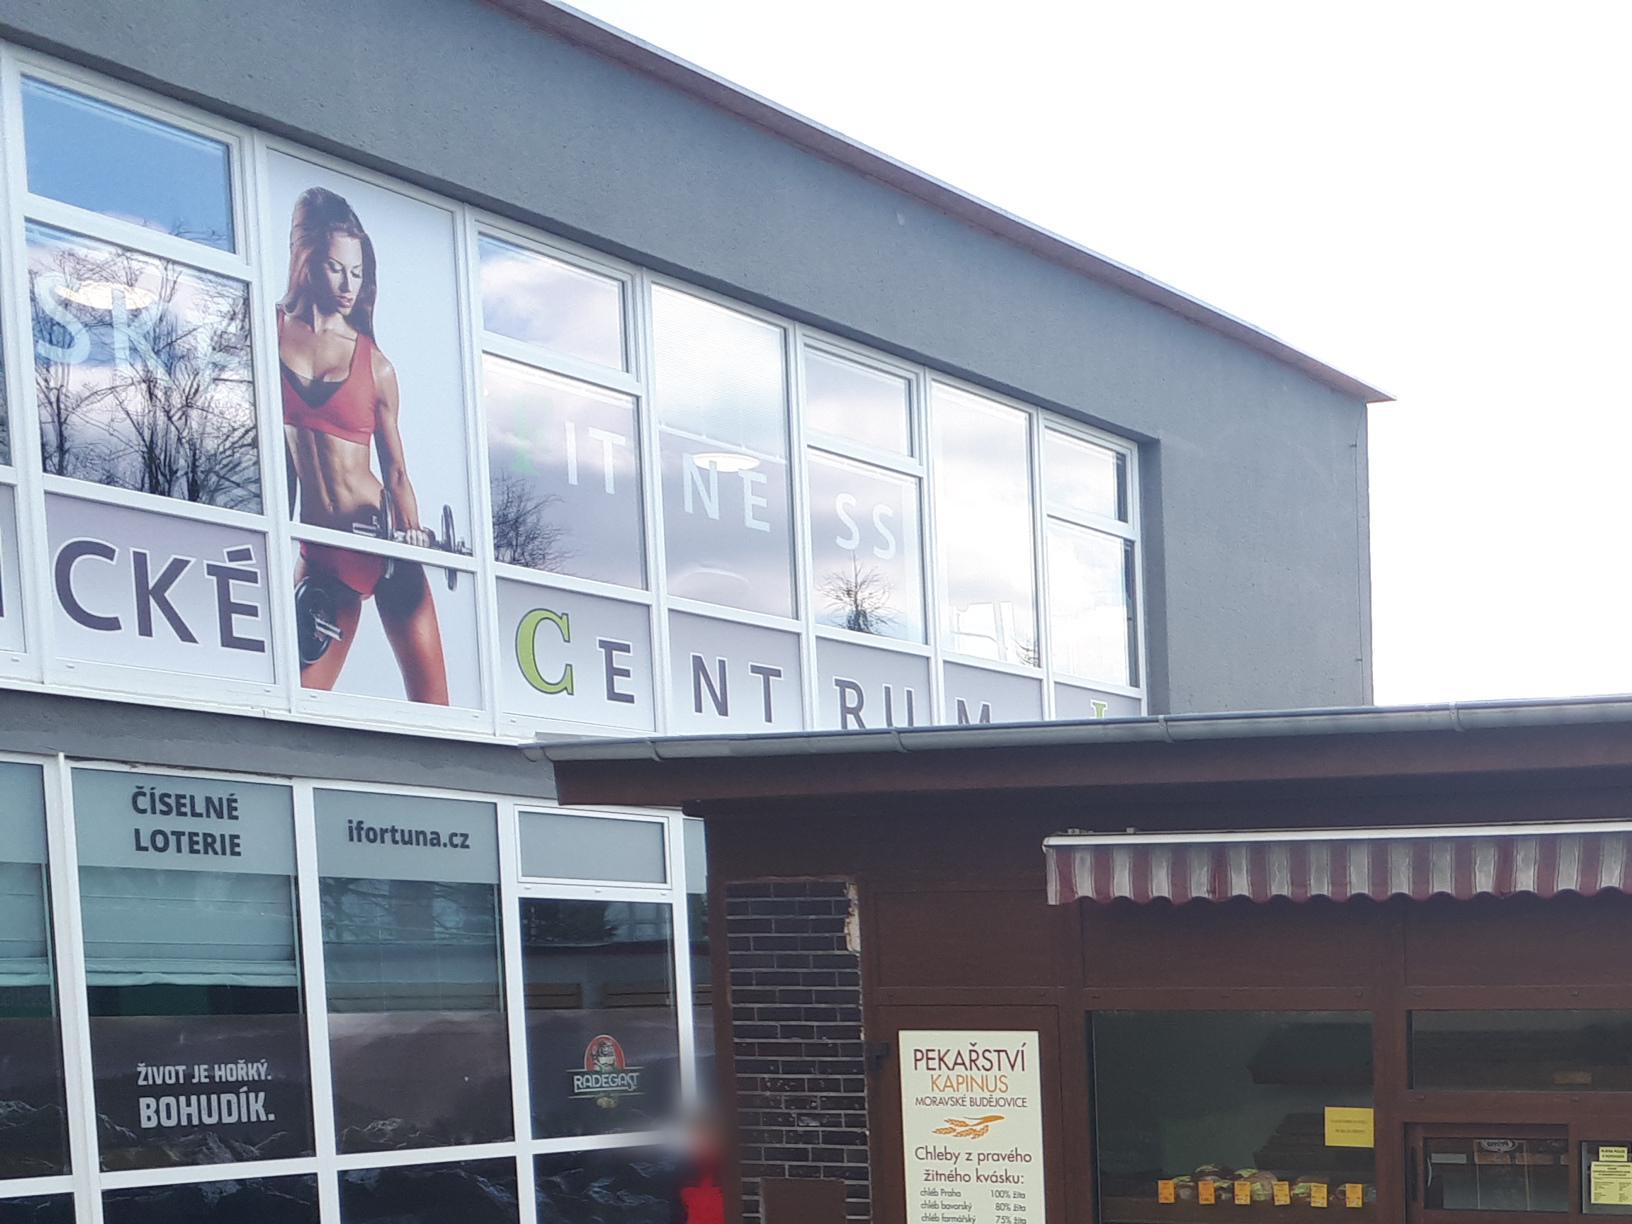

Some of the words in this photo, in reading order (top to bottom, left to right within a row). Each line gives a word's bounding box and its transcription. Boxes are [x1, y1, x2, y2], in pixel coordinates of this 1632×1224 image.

[132, 785, 240, 821] ČÍSELNÉ
[134, 828, 242, 857] LOTERIE
[348, 819, 471, 849] ifortuna.cz
[913, 1042, 1027, 1072] PEKAŘSTVÍ
[137, 1062, 187, 1086] ŽIVOT
[192, 1065, 210, 1084] JE
[215, 1059, 272, 1082] HOŘKÝ.
[573, 1072, 640, 1093] RADEGAST
[930, 1074, 1009, 1094] KAPINUS
[139, 1086, 276, 1129] BOHUDÍK.
[915, 1094, 967, 1107] MORAVSKÉ
[969, 1095, 1028, 1108] BUDĚJOVICE
[915, 1145, 961, 1165] Chleby
[965, 1152, 973, 1161] z
[977, 1147, 1032, 1166] pravého
[923, 1167, 971, 1183] žitného
[976, 1168, 1024, 1184] kvásku:
[990, 1189, 1011, 1198] 100%
